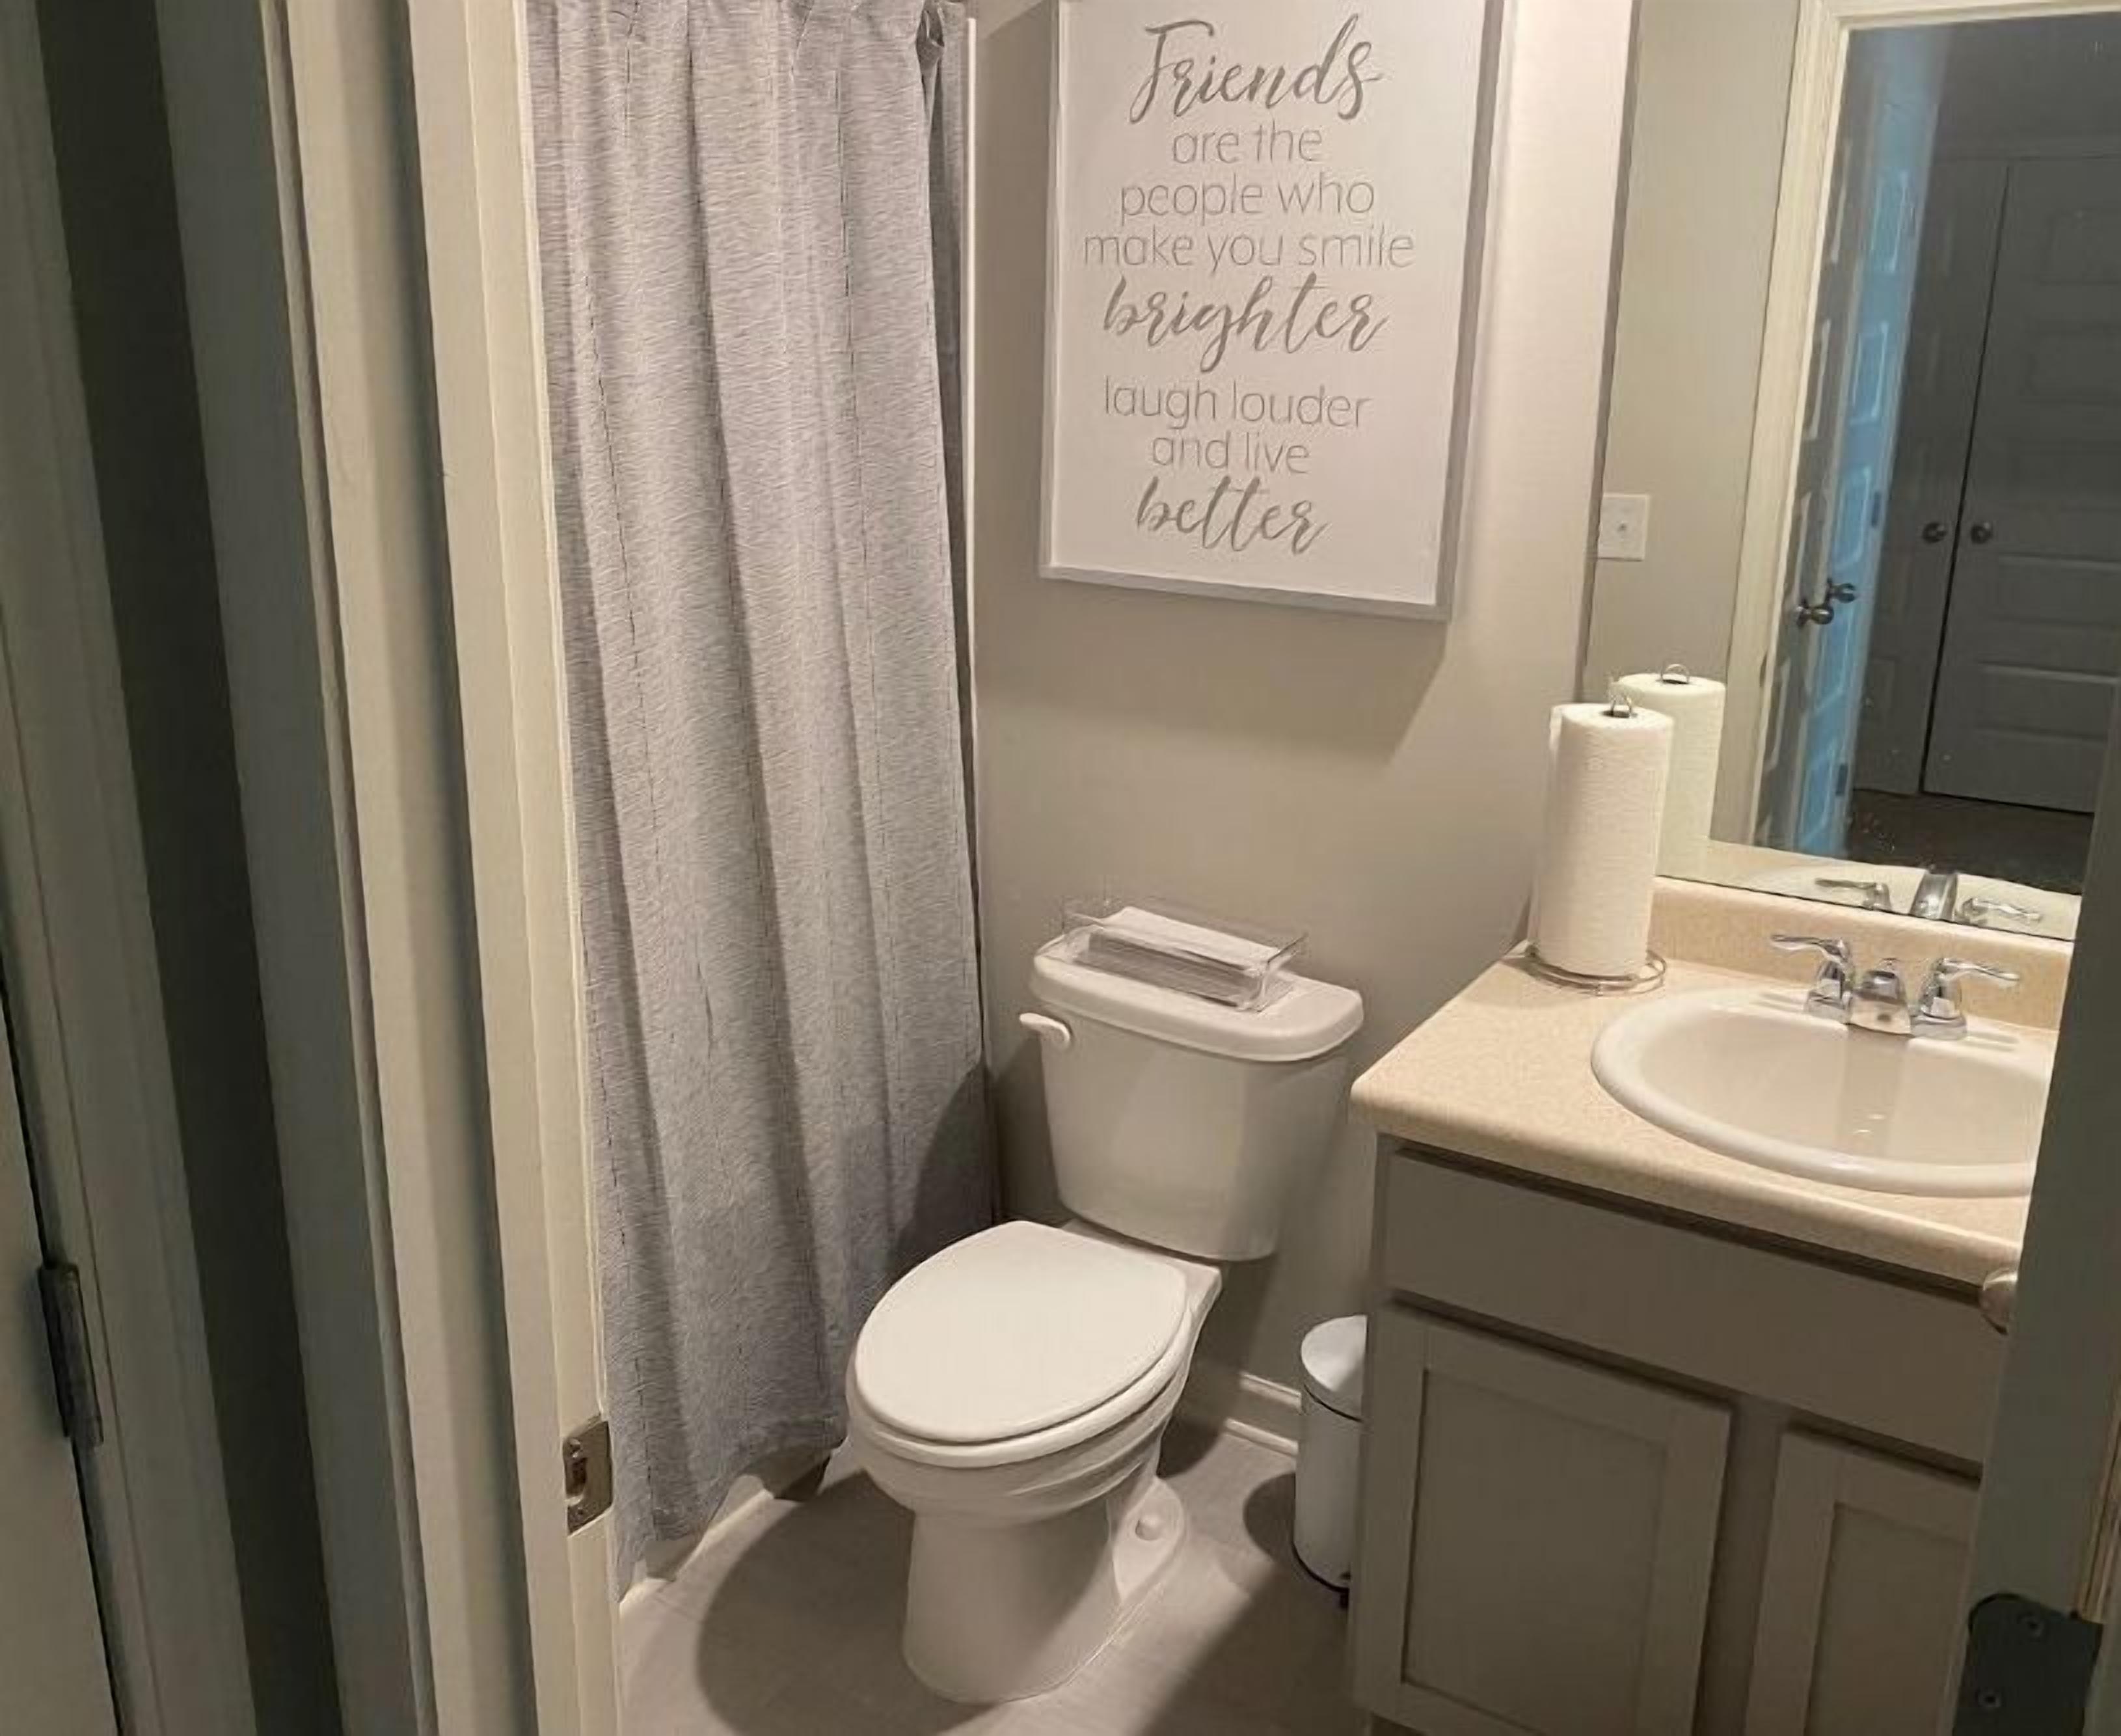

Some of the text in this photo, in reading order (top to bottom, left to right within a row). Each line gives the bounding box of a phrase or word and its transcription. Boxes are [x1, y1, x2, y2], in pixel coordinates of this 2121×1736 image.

[1129, 13, 1383, 124] Friends
[1173, 120, 1322, 164] are the
[1120, 172, 1375, 226] people who
[1084, 224, 1414, 275] make you smile
[1103, 271, 1390, 373] brighter
[1105, 376, 1372, 429] laugh louder
[1152, 431, 1310, 474] and live
[1137, 476, 1332, 554] better
